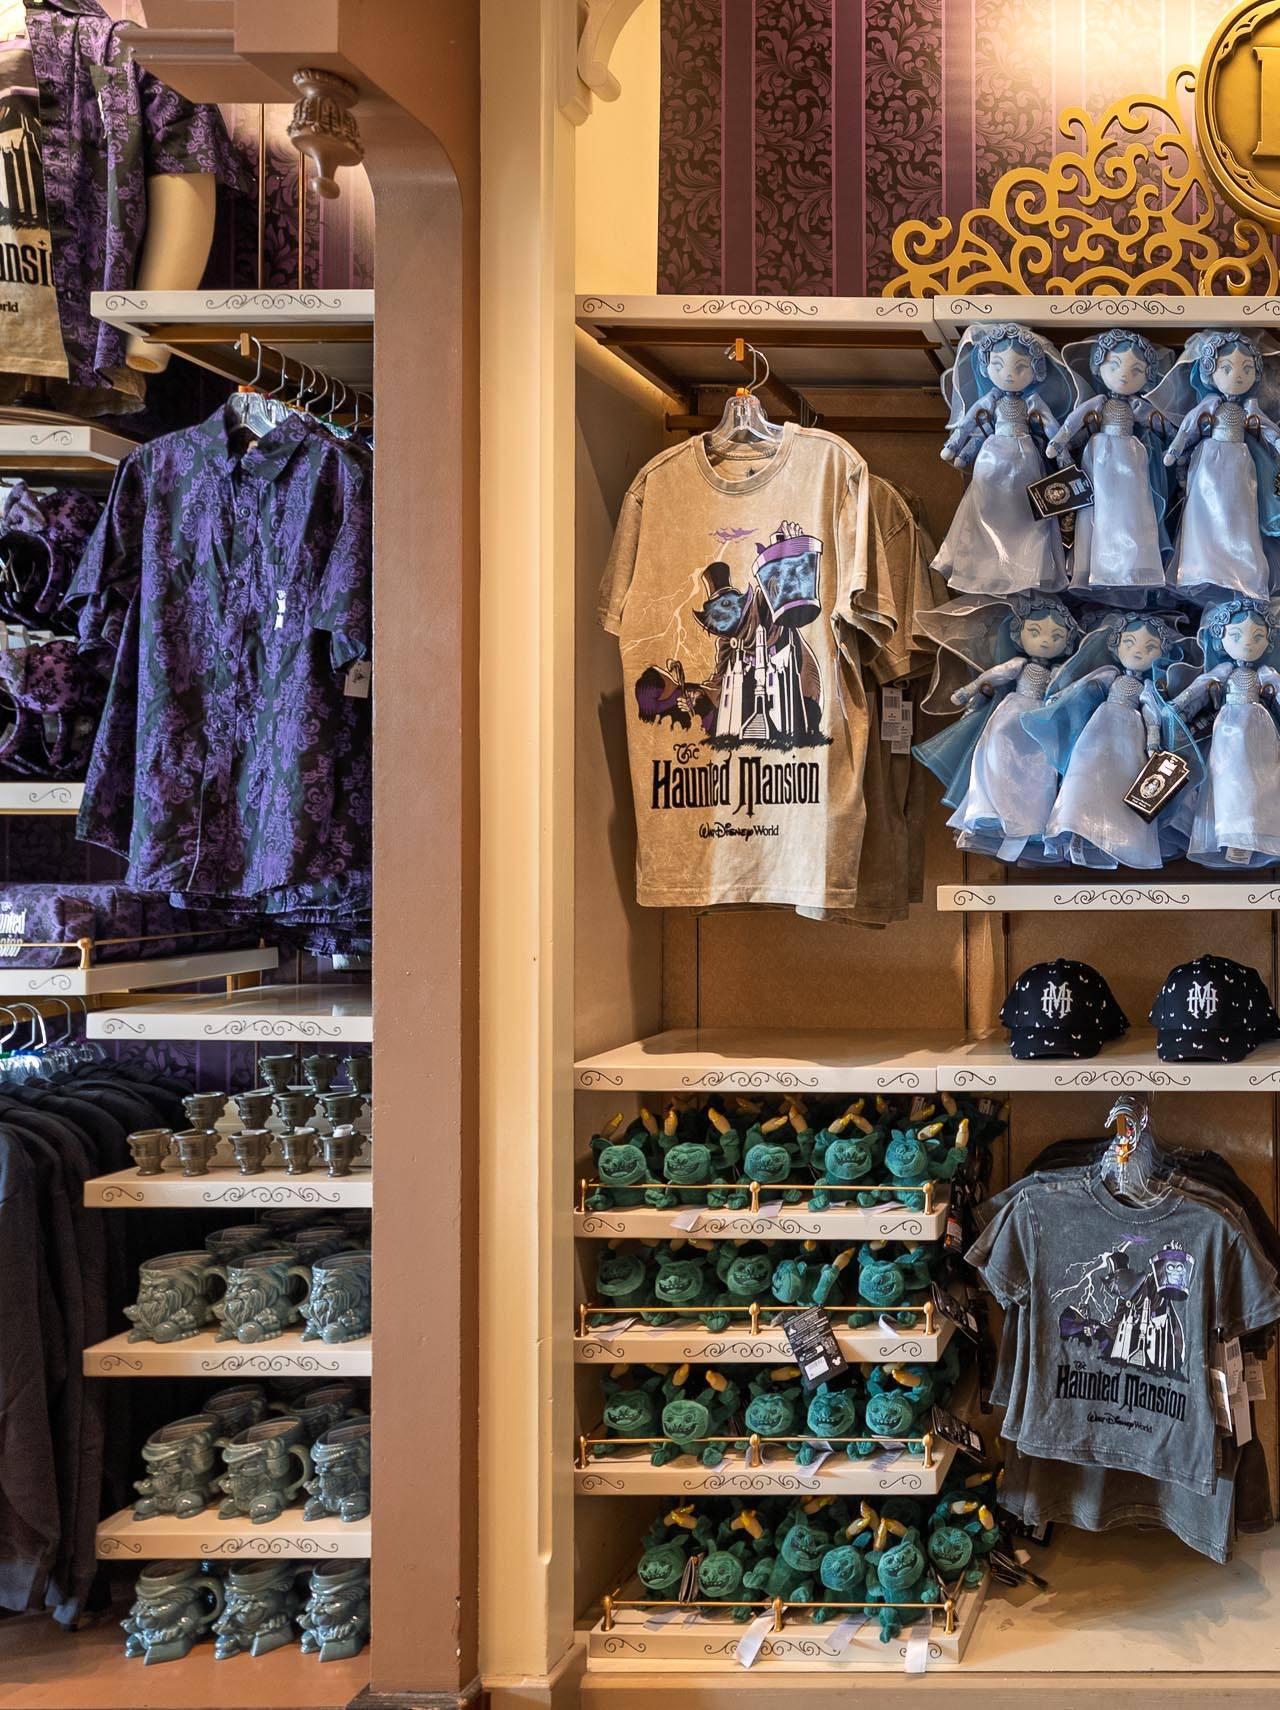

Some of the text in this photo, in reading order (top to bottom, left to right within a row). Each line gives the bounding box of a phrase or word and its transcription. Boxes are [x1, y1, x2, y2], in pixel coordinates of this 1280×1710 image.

[673, 743, 700, 764] The
[651, 750, 820, 818] Haunted Mansion
[699, 822, 779, 841] Walt Disney World
[1056, 1365, 1187, 1422] Haunted Mansion
[1103, 1412, 1135, 1430] Disney
[1134, 1421, 1153, 1433] World
